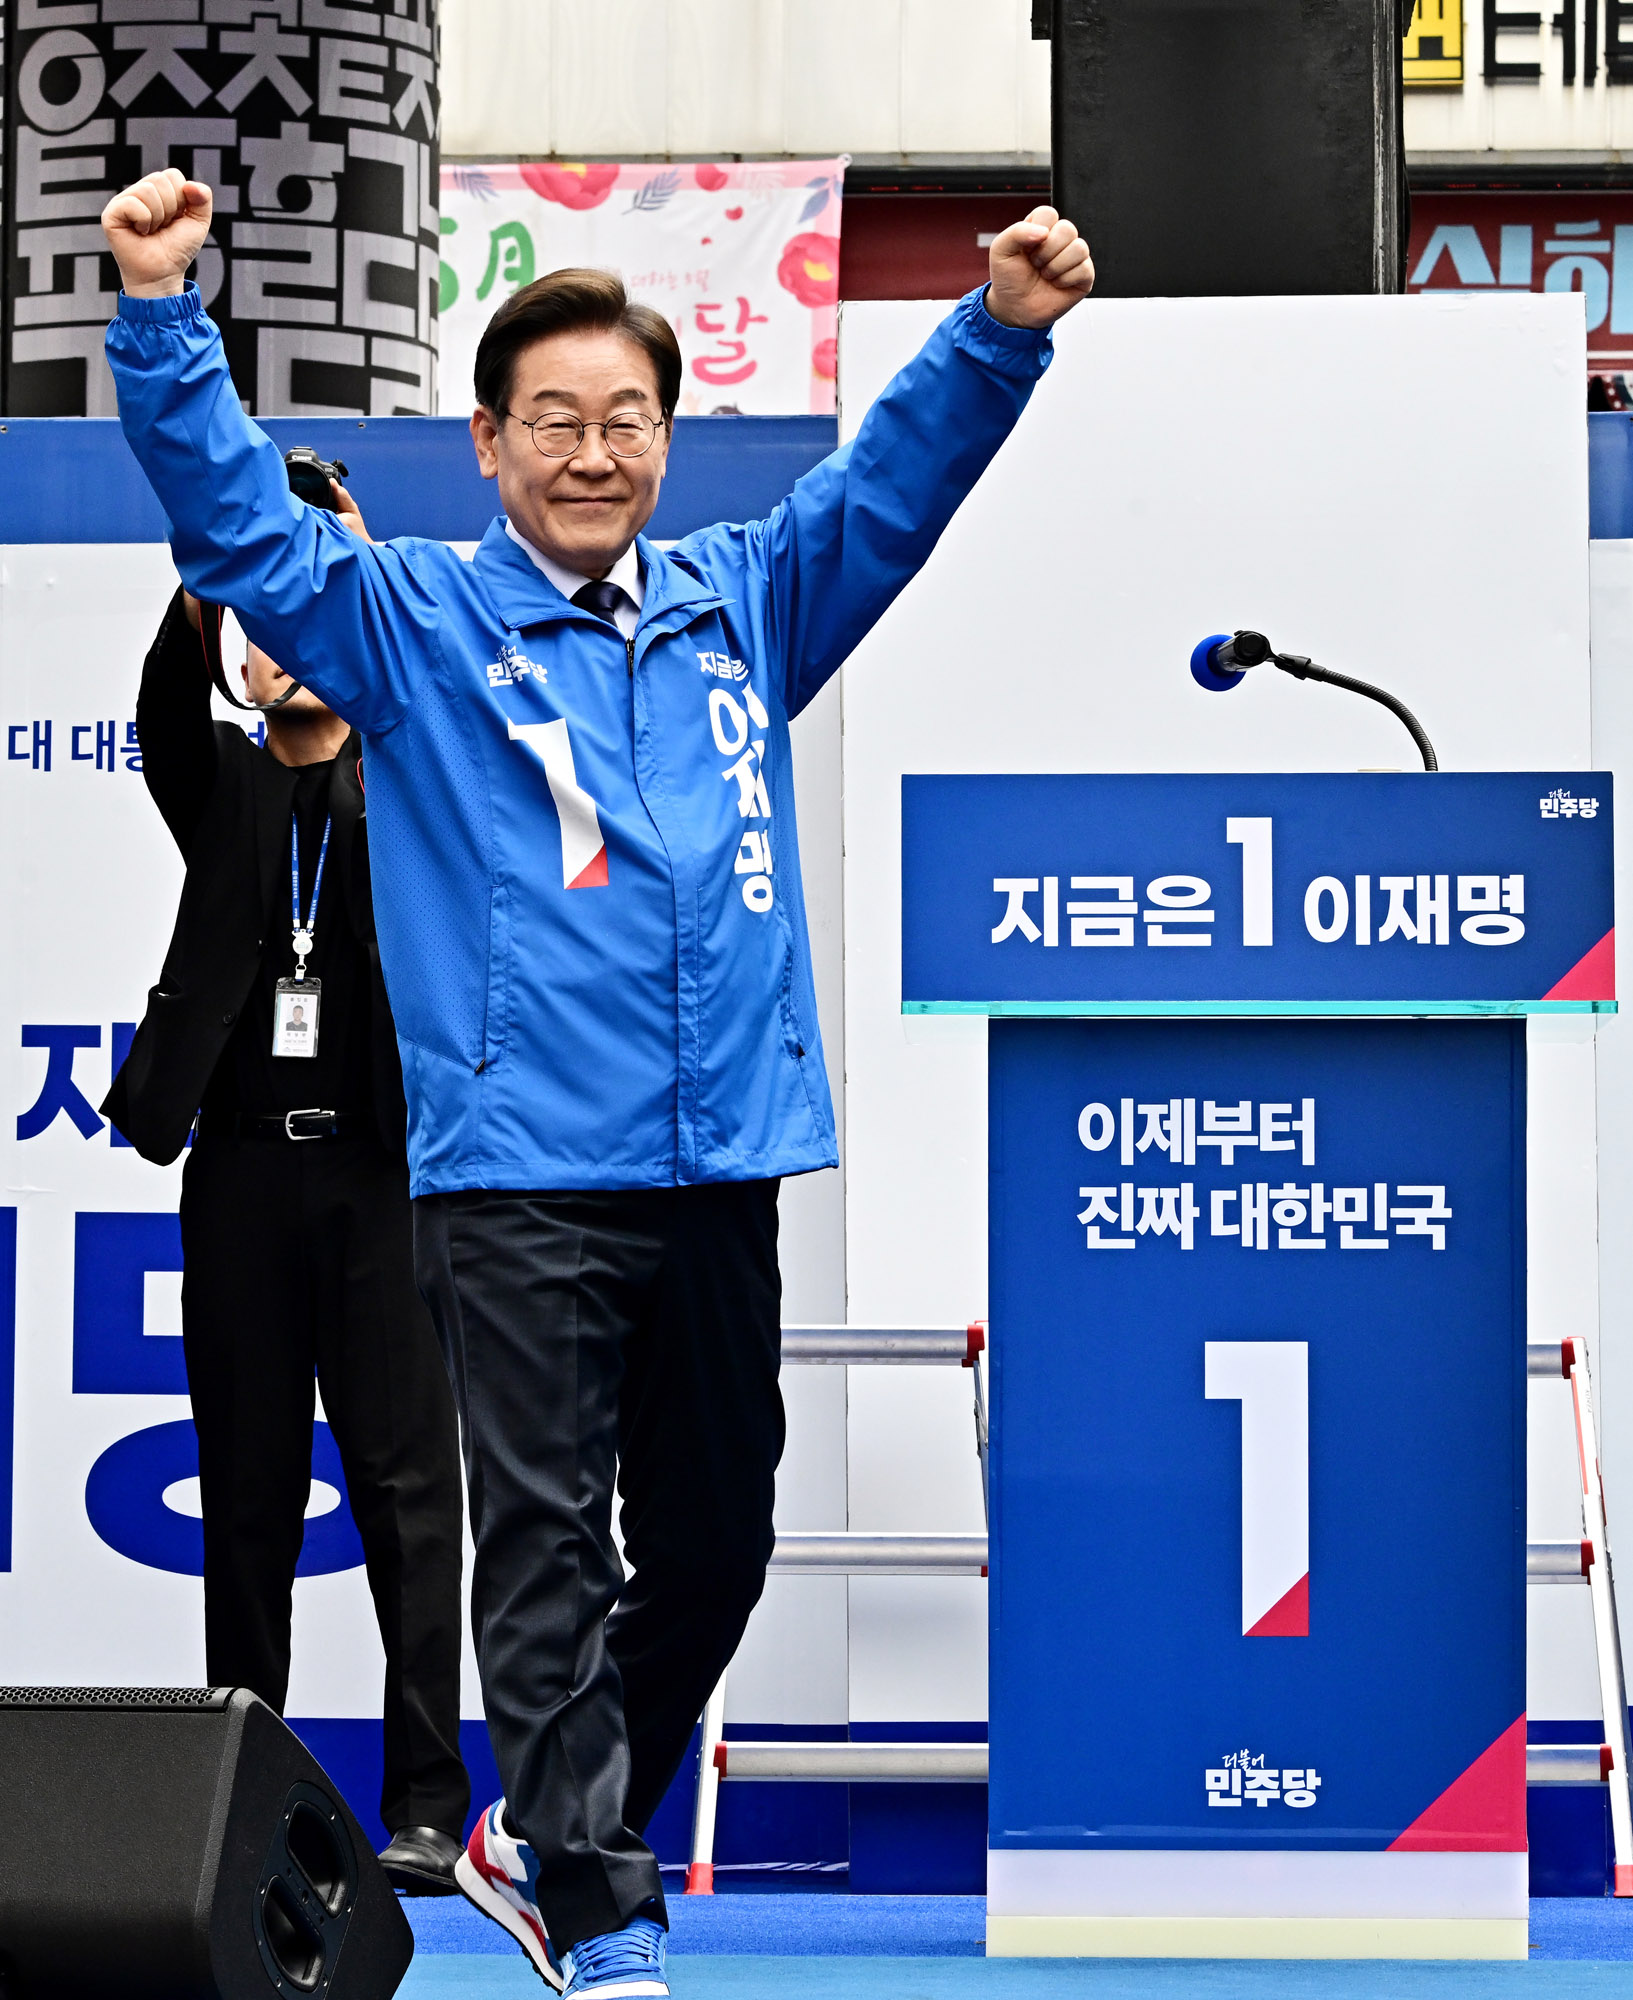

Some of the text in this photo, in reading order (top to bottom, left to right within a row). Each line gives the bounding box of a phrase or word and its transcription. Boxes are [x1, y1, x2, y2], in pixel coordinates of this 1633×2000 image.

[691, 296, 769, 386] 달
[486, 655, 548, 688] 민주당
[696, 651, 750, 682] 지금은
[507, 717, 609, 889] 1
[1539, 797, 1600, 819] 민주당
[991, 817, 1526, 947] 지금은 1 이재명
[1077, 1098, 1315, 1166] 이제부터
[1076, 1182, 1453, 1251] 진짜 대한민국
[1205, 1341, 1309, 1637] 1
[1205, 1768, 1322, 1808] 민주당
[1222, 1748, 1265, 1771] 더불어
